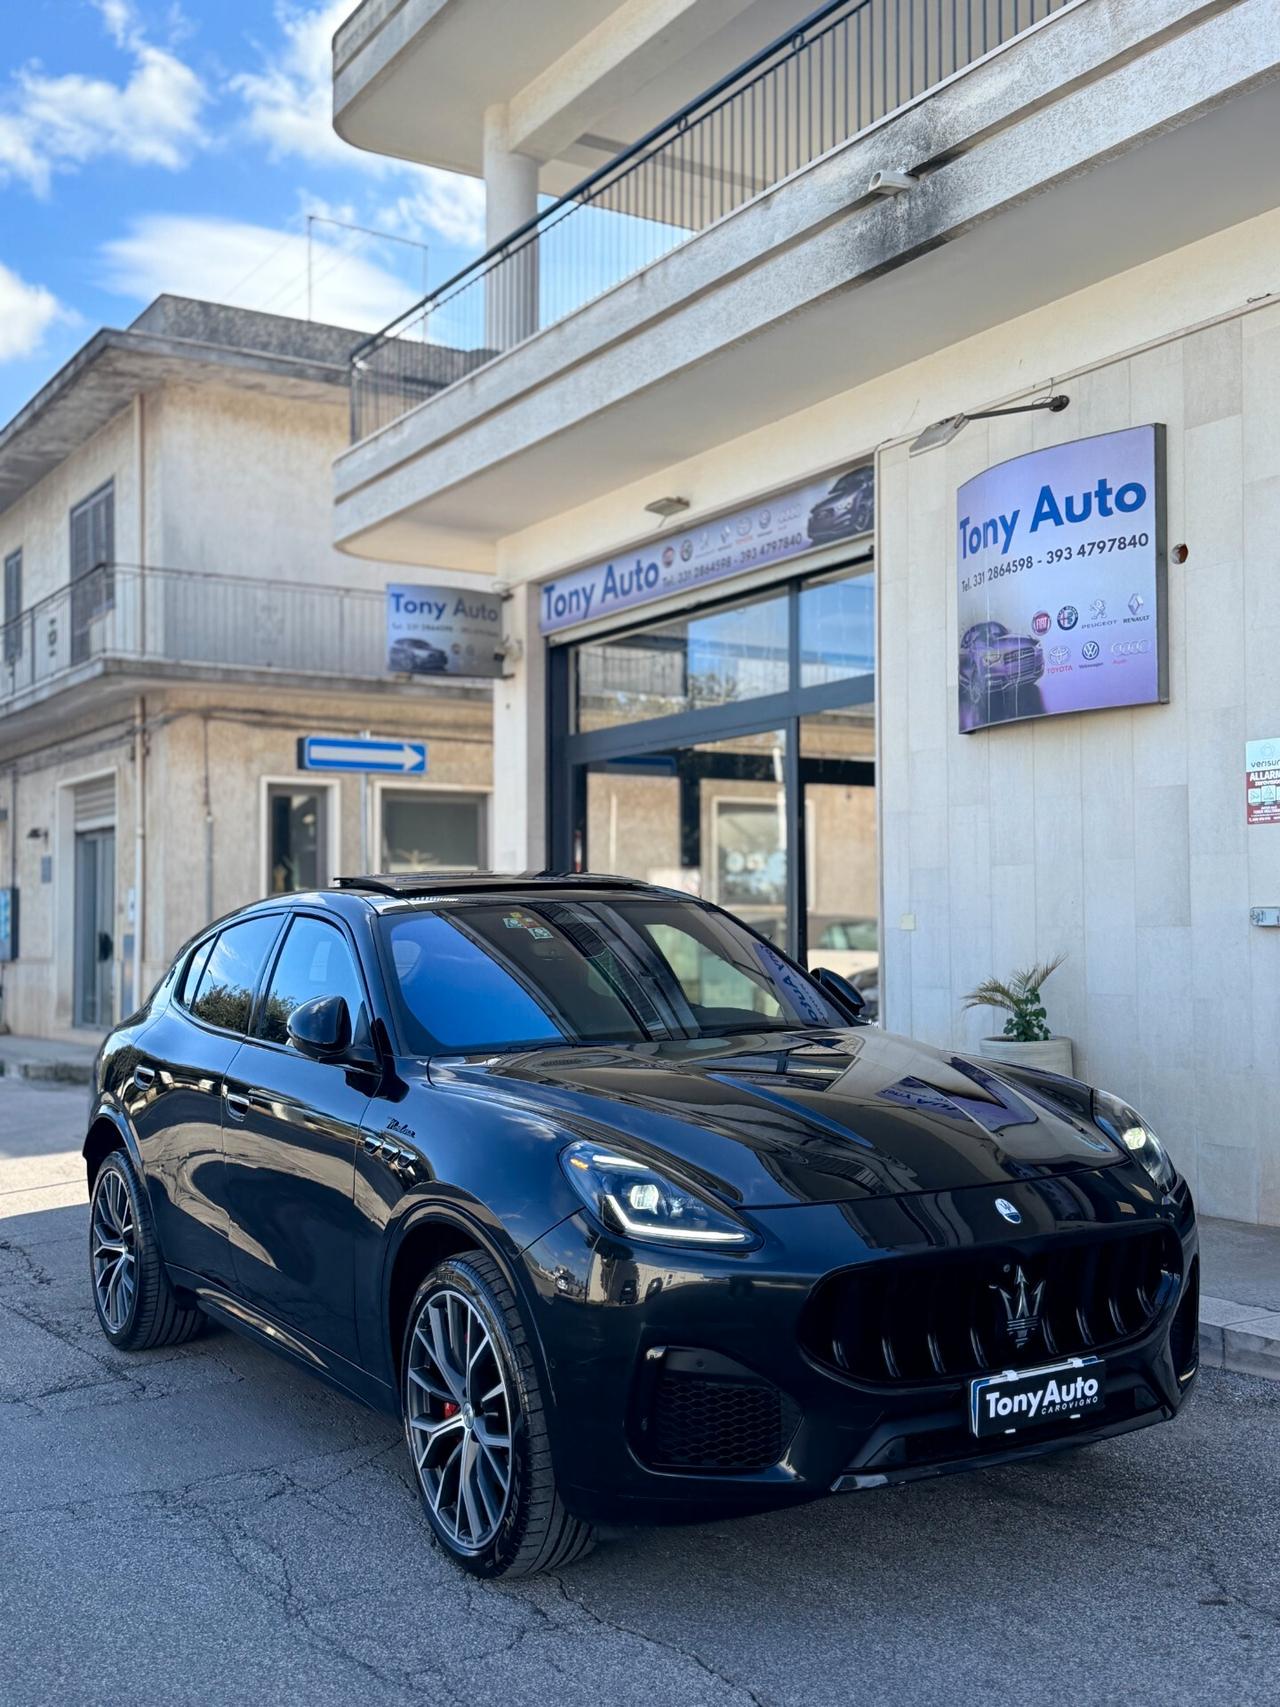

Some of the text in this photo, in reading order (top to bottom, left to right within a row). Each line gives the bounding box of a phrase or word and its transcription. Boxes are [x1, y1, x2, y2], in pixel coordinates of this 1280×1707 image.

[959, 477, 1147, 560] Tony Auto
[973, 571, 985, 587] 331
[987, 555, 1034, 581] 2864598
[1046, 546, 1073, 564] 393
[1076, 532, 1149, 557] 4797840
[543, 559, 660, 621] Tony Auto
[390, 592, 499, 622] Tony Auto
[1081, 620, 1118, 630] PEUGEOT
[1046, 665, 1073, 674] TOYOTA
[1041, 1396, 1099, 1415] CAROVIGNO
